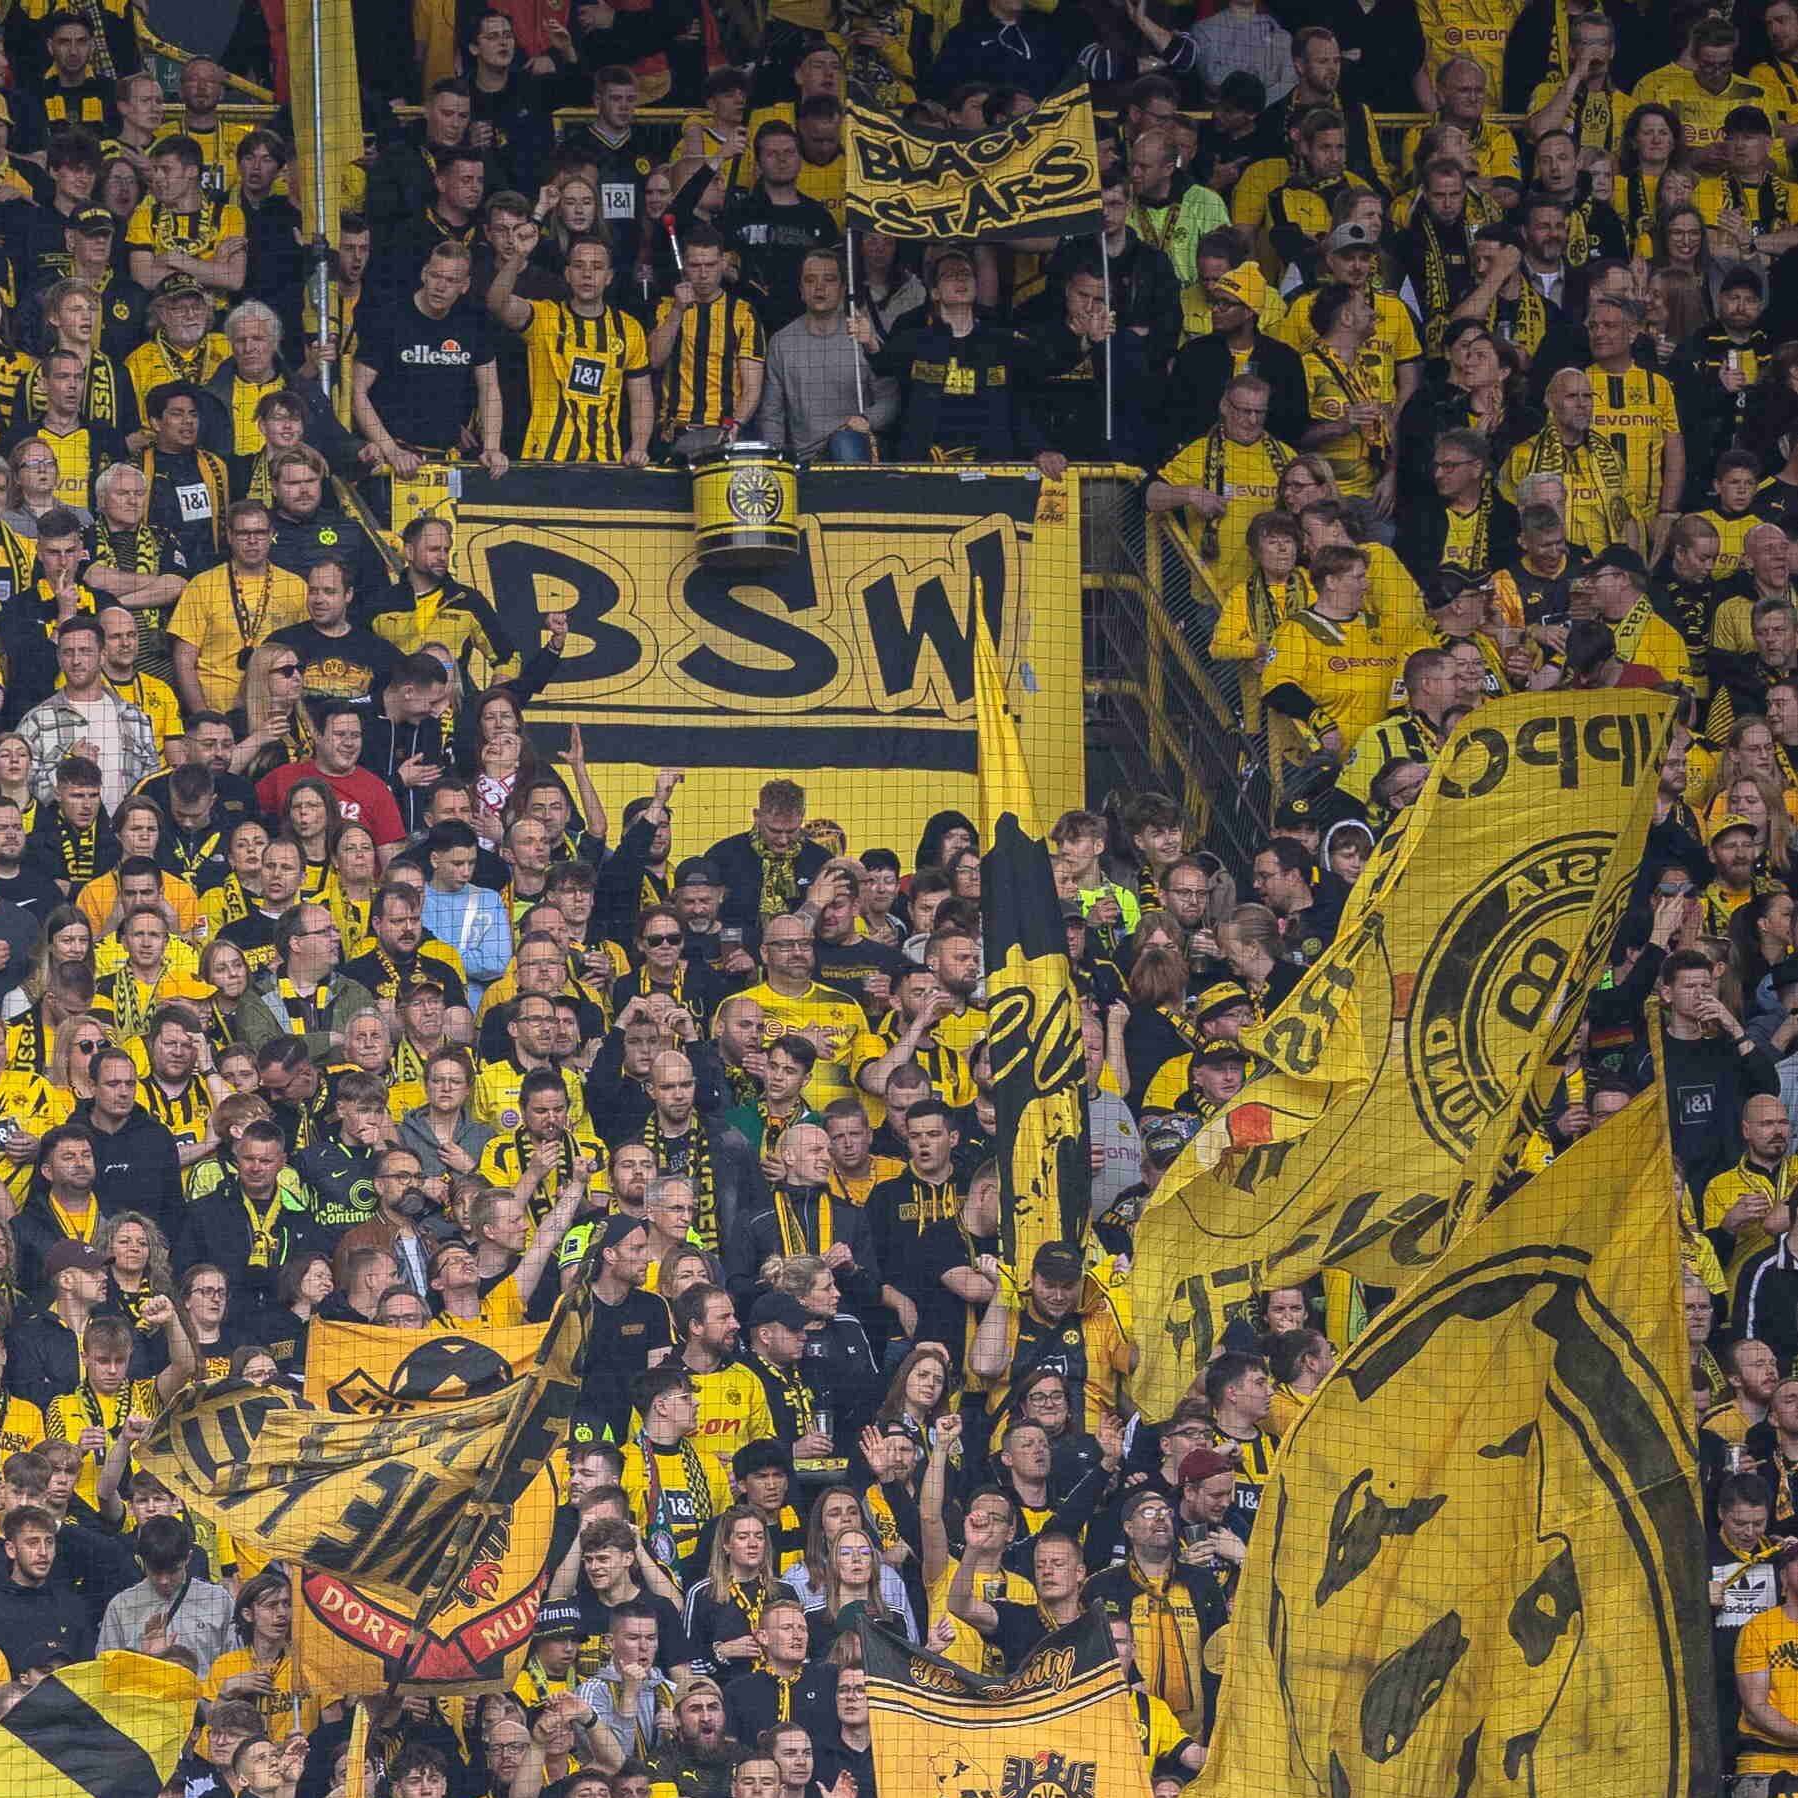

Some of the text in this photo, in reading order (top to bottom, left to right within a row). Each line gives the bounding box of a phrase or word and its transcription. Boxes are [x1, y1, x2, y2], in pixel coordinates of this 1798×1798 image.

[858, 108, 1067, 186] BLACK
[606, 191, 632, 211] 1&1
[875, 144, 1093, 239] STARS
[401, 347, 471, 366] ellesse
[574, 363, 601, 388] 1&1
[486, 518, 1003, 701] BSW
[321, 1583, 407, 1651] DORT
